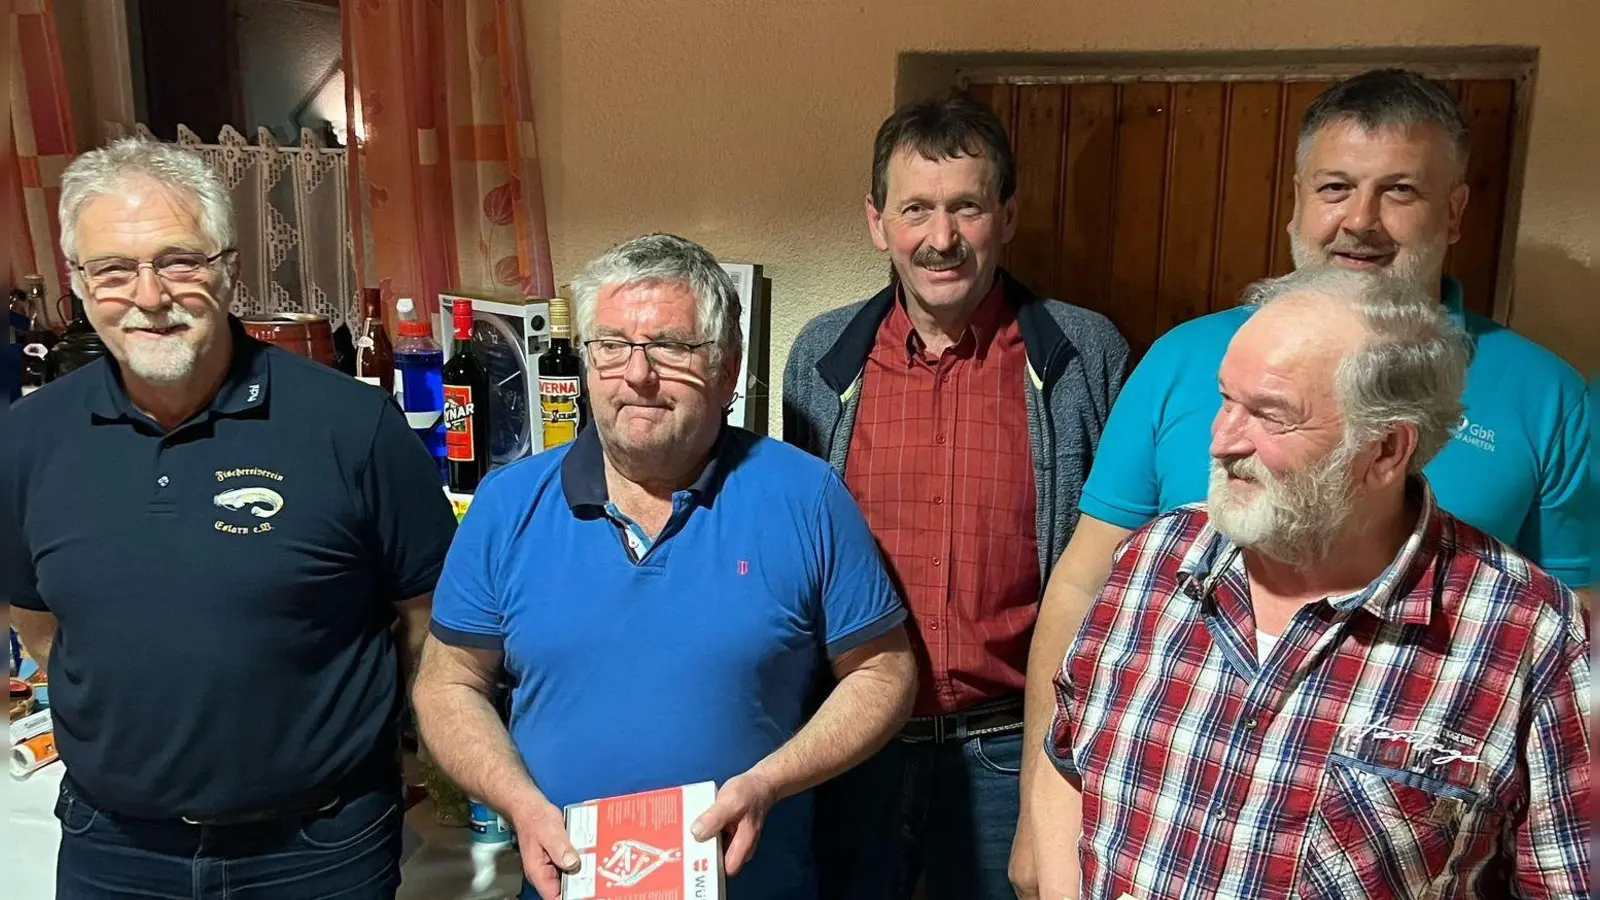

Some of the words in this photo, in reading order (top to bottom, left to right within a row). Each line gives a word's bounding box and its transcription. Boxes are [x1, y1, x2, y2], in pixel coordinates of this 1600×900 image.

[538, 382, 576, 394] VERNA
[1470, 423, 1495, 443] GbR
[215, 467, 284, 482] Fischereiverein
[695, 874, 706, 900] WÜ
